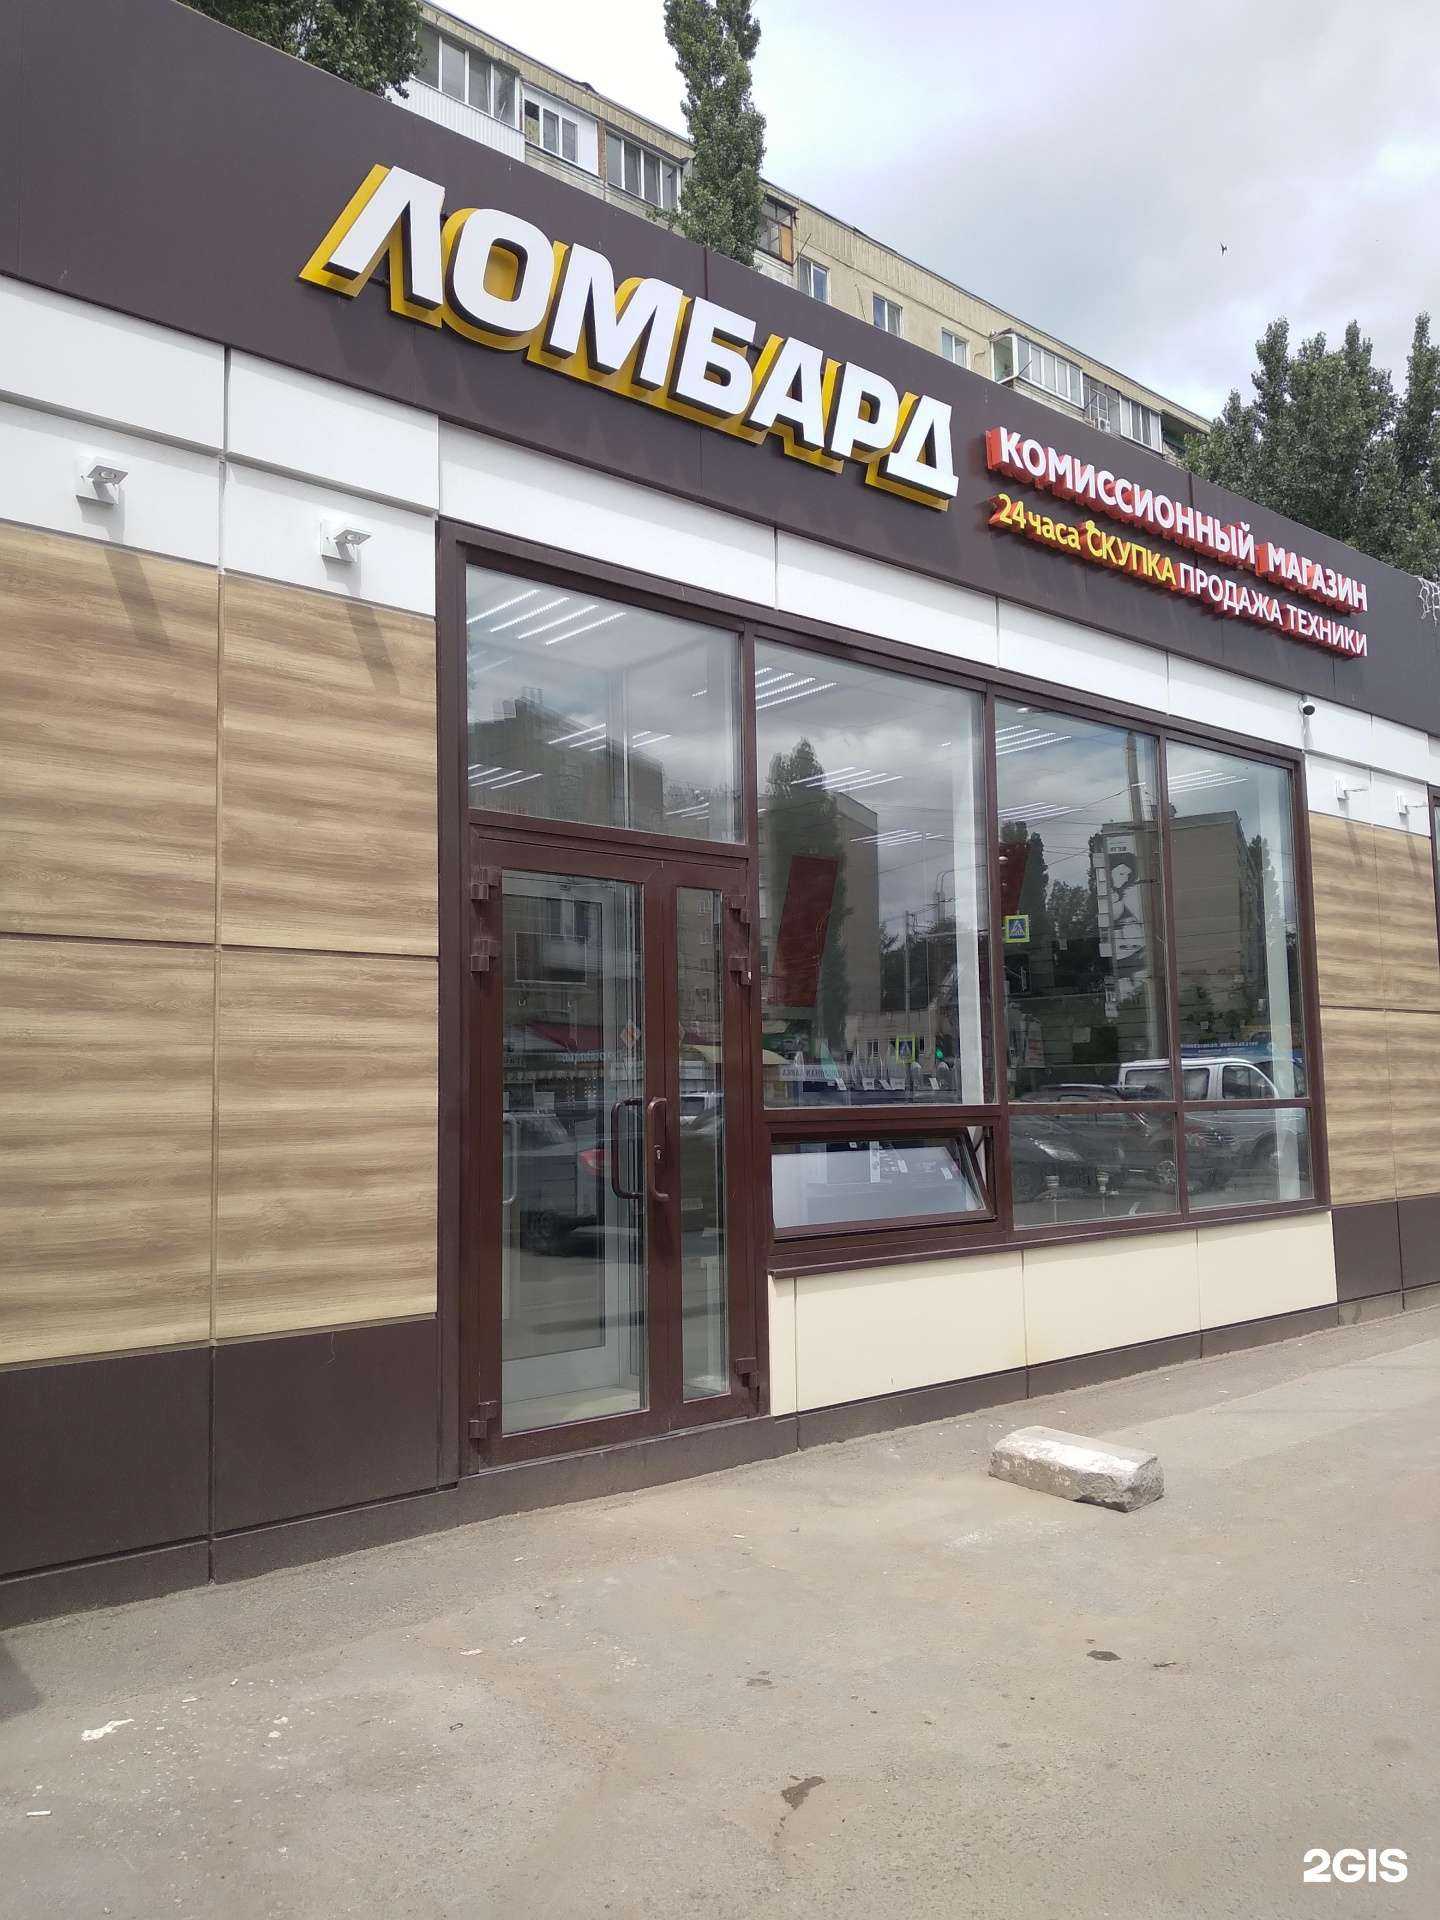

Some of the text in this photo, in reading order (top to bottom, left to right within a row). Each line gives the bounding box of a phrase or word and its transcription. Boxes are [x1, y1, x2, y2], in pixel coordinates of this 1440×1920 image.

[326, 165, 960, 498] ЛОМБАРД
[997, 493, 1368, 657] 24 часа СКУПКА ПРОДАЖА ТЕХНИКИ
[999, 426, 1368, 612] КОМИССИОННЫЙ МАГАЗИН
